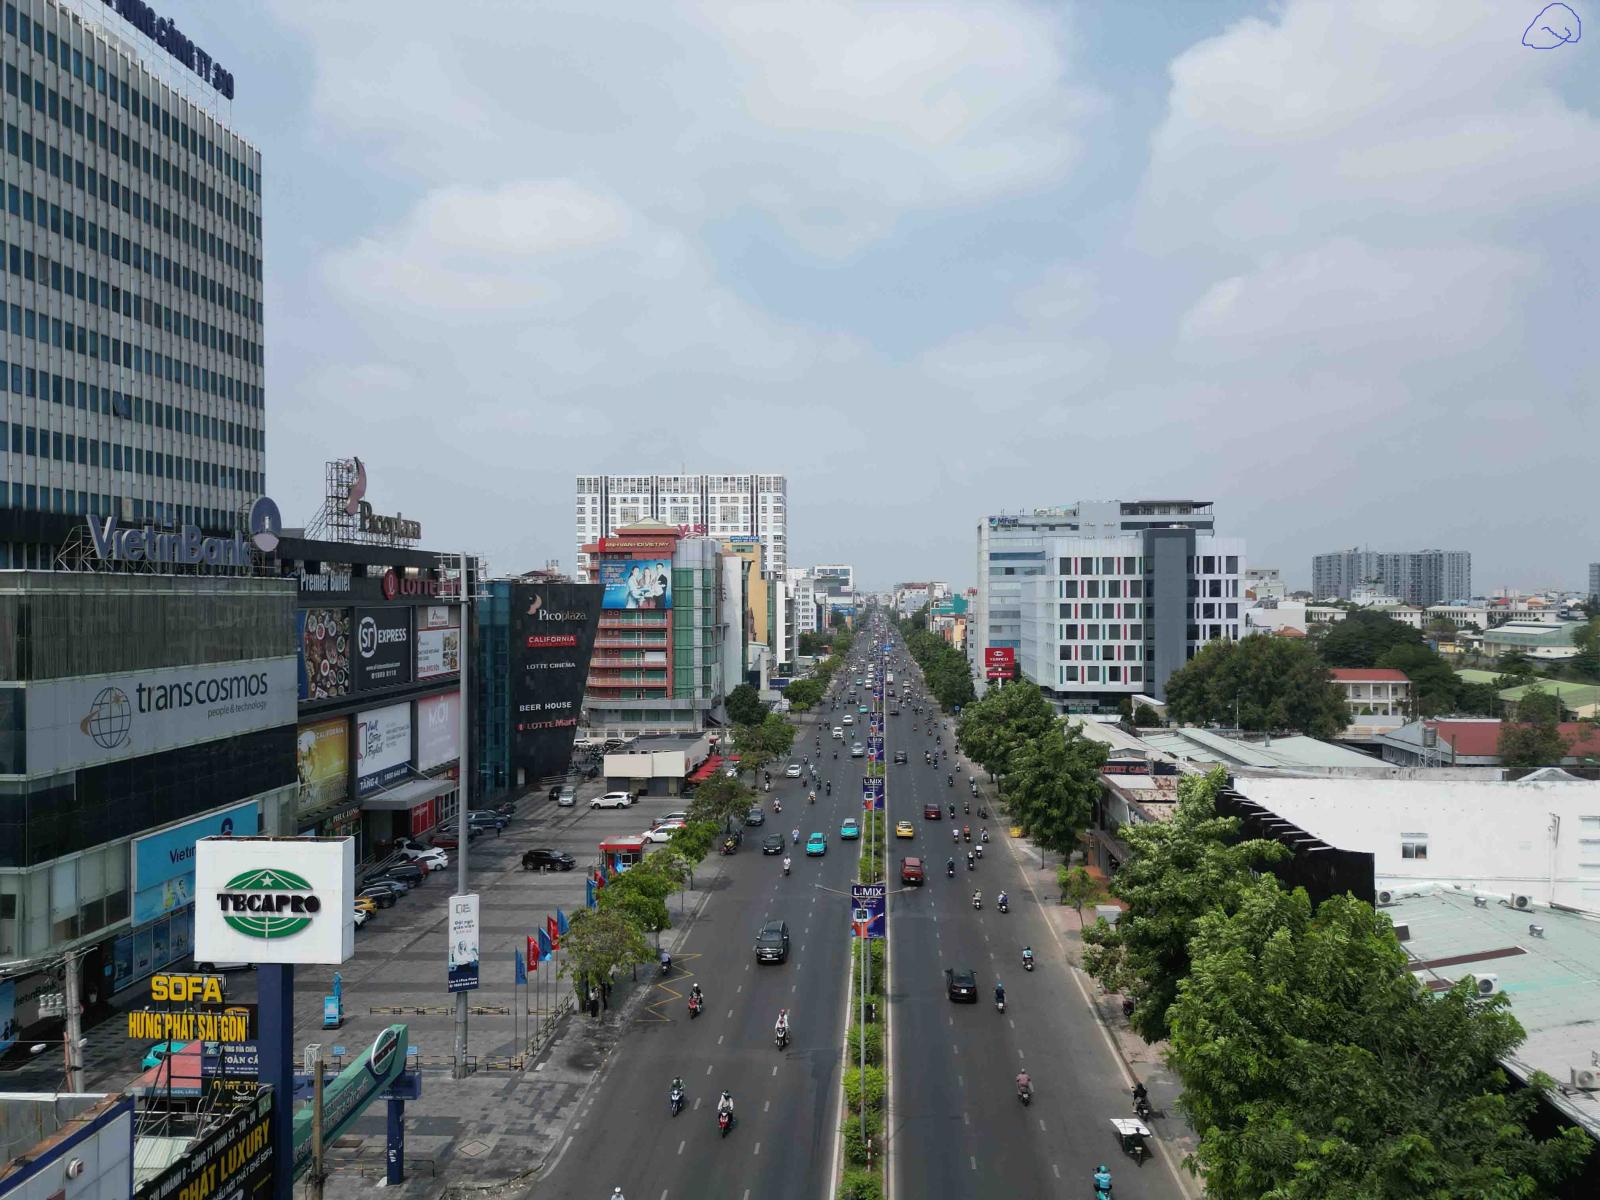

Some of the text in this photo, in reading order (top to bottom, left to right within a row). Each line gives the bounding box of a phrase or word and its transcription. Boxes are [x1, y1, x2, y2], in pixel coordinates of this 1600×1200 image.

[86, 514, 251, 566] VietinBank
[300, 567, 329, 592] Premier
[538, 609, 586, 622] Picoplaza
[378, 628, 407, 643] EXPRESS
[526, 663, 549, 671] LOTTE
[136, 672, 268, 713] transcosmos
[208, 706, 230, 719] people
[519, 702, 572, 711] BEER HOUSE
[526, 718, 577, 730] LOTTE Mart
[217, 893, 320, 913] TECAPRO
[152, 976, 223, 1003] SOFA
[128, 1010, 162, 1039] HƯNG
[164, 1009, 195, 1041] PHÁT
[197, 1009, 218, 1041] SÀI
[225, 1054, 246, 1064] OÀN
[220, 1117, 270, 1182] LUXURY
